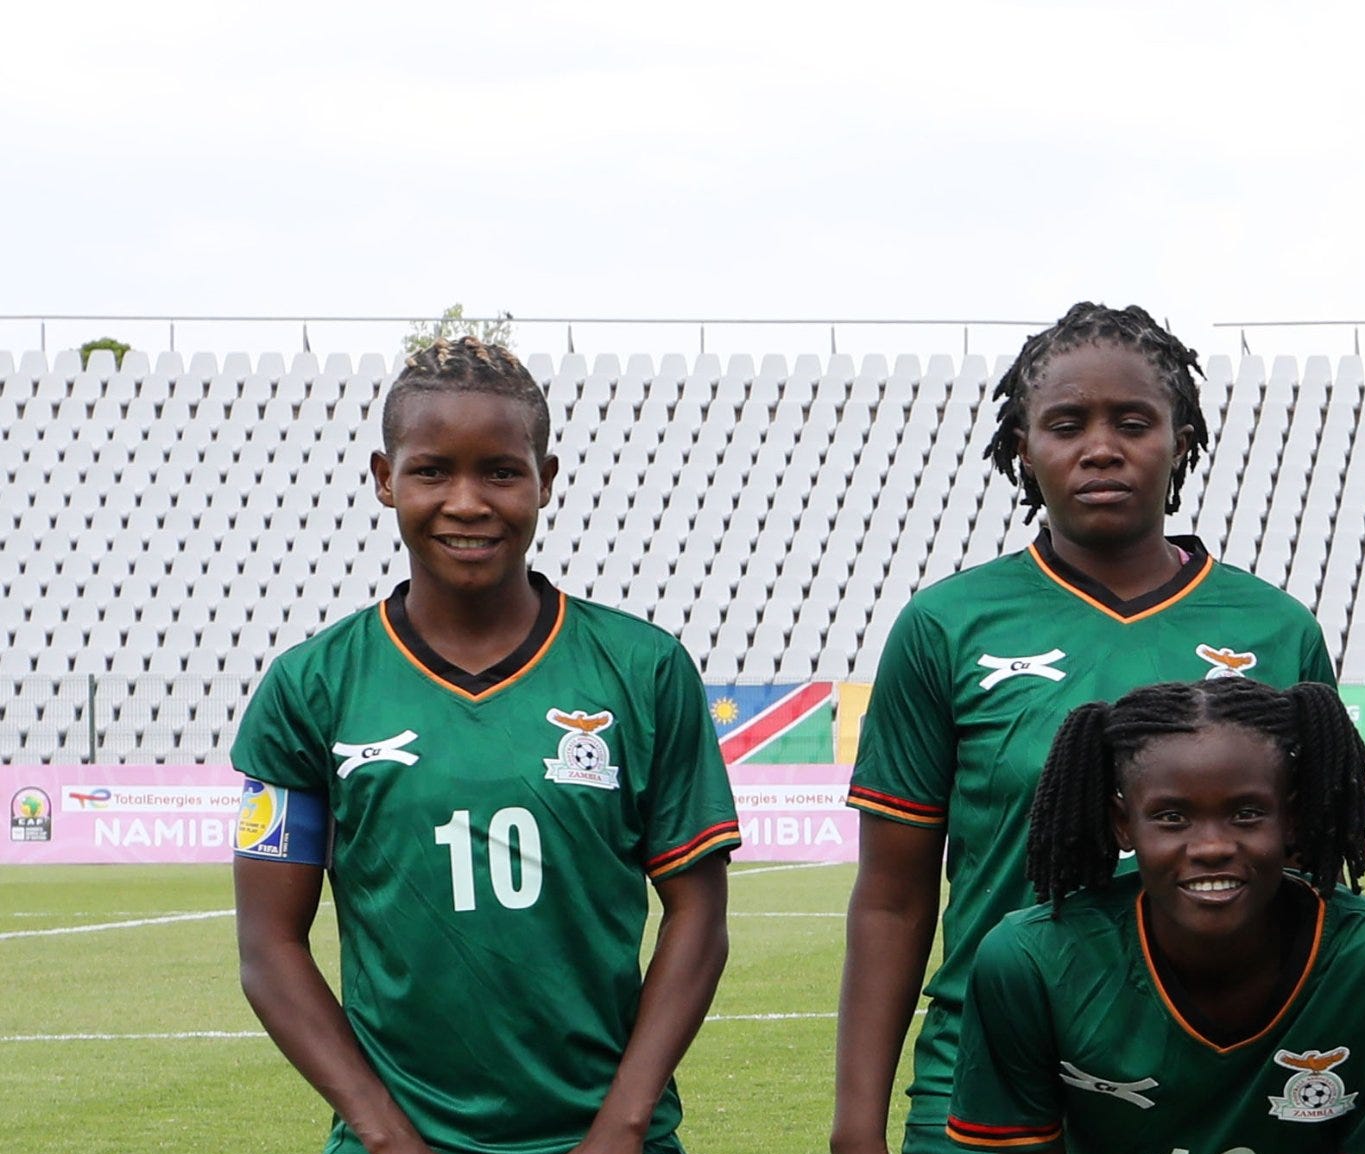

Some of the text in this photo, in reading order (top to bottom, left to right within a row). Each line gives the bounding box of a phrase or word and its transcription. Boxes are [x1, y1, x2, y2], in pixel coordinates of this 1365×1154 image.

[1010, 661, 1031, 670] Cu
[361, 747, 381, 758] Cu
[114, 794, 202, 808] TotalEnergies
[785, 795, 832, 803] WOMEN
[94, 818, 236, 847] NAMIBI
[740, 817, 842, 845] MIBIA
[258, 844, 279, 853] FIFA
[434, 807, 542, 911] 10
[1293, 1108, 1335, 1118] ZAMBIA
